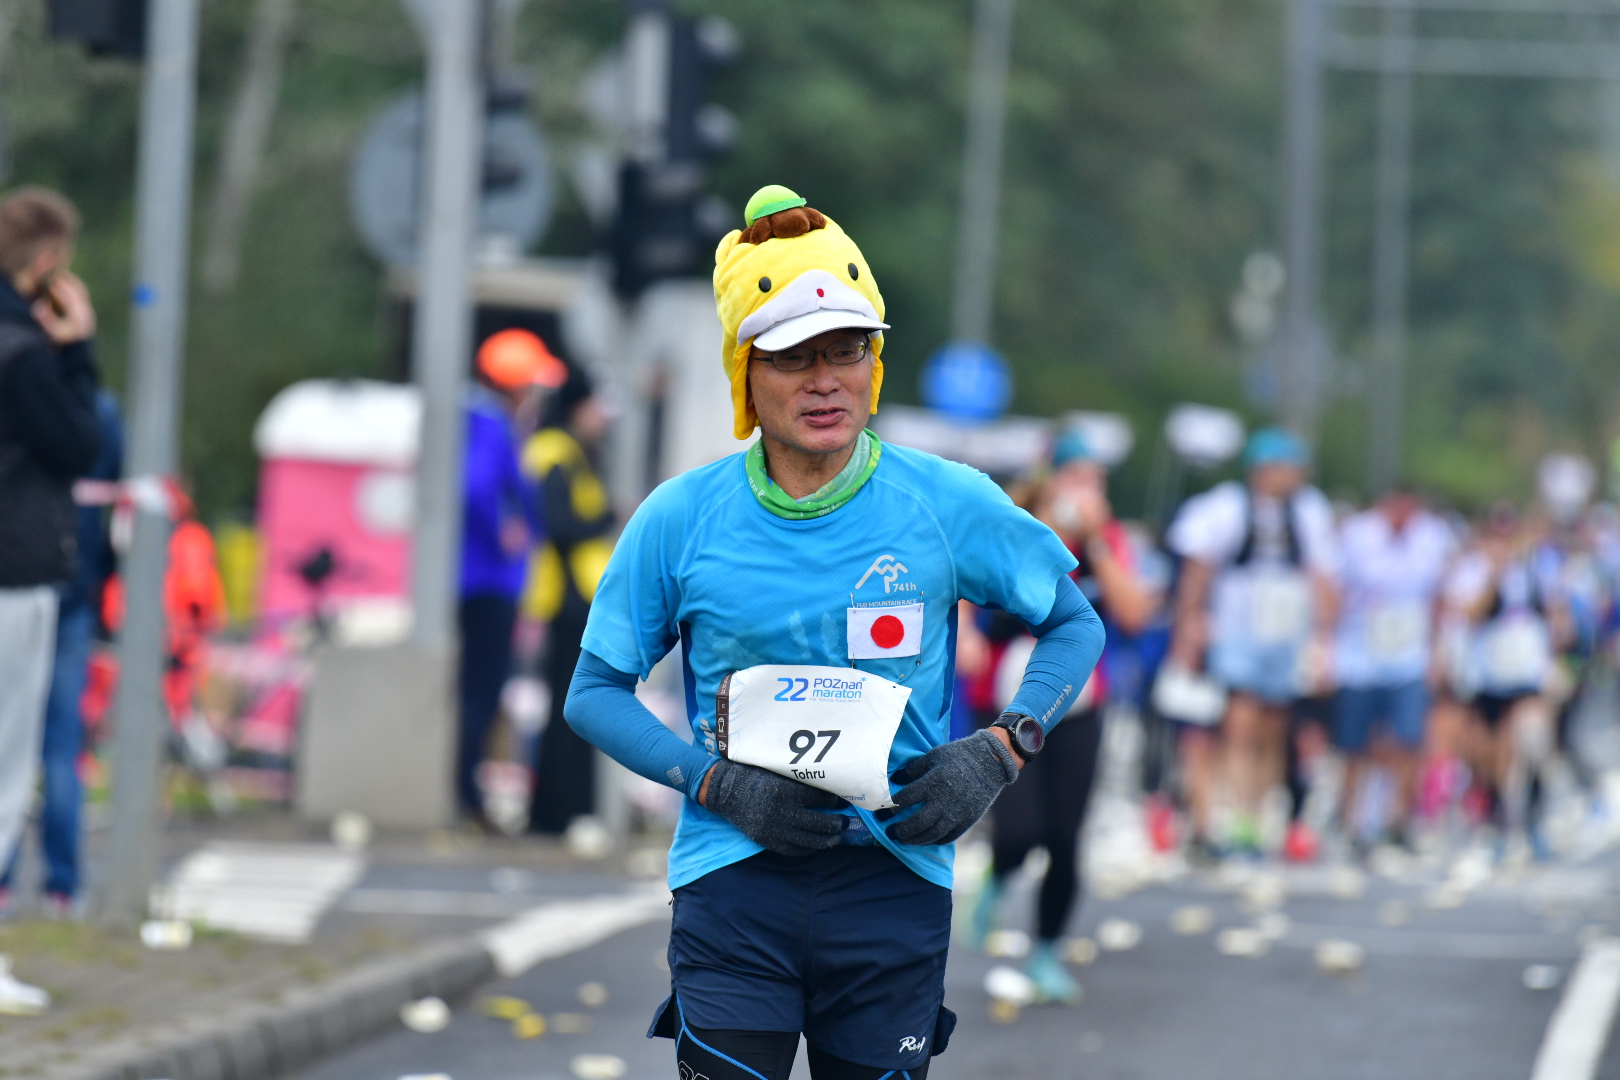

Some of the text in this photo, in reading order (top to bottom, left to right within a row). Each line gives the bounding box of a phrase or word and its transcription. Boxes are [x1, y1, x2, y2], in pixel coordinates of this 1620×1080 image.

[893, 582, 917, 592] 74th
[774, 677, 809, 701] 22
[812, 689, 861, 698] maraton
[789, 729, 841, 764] 97
[791, 768, 825, 779] Tohru
